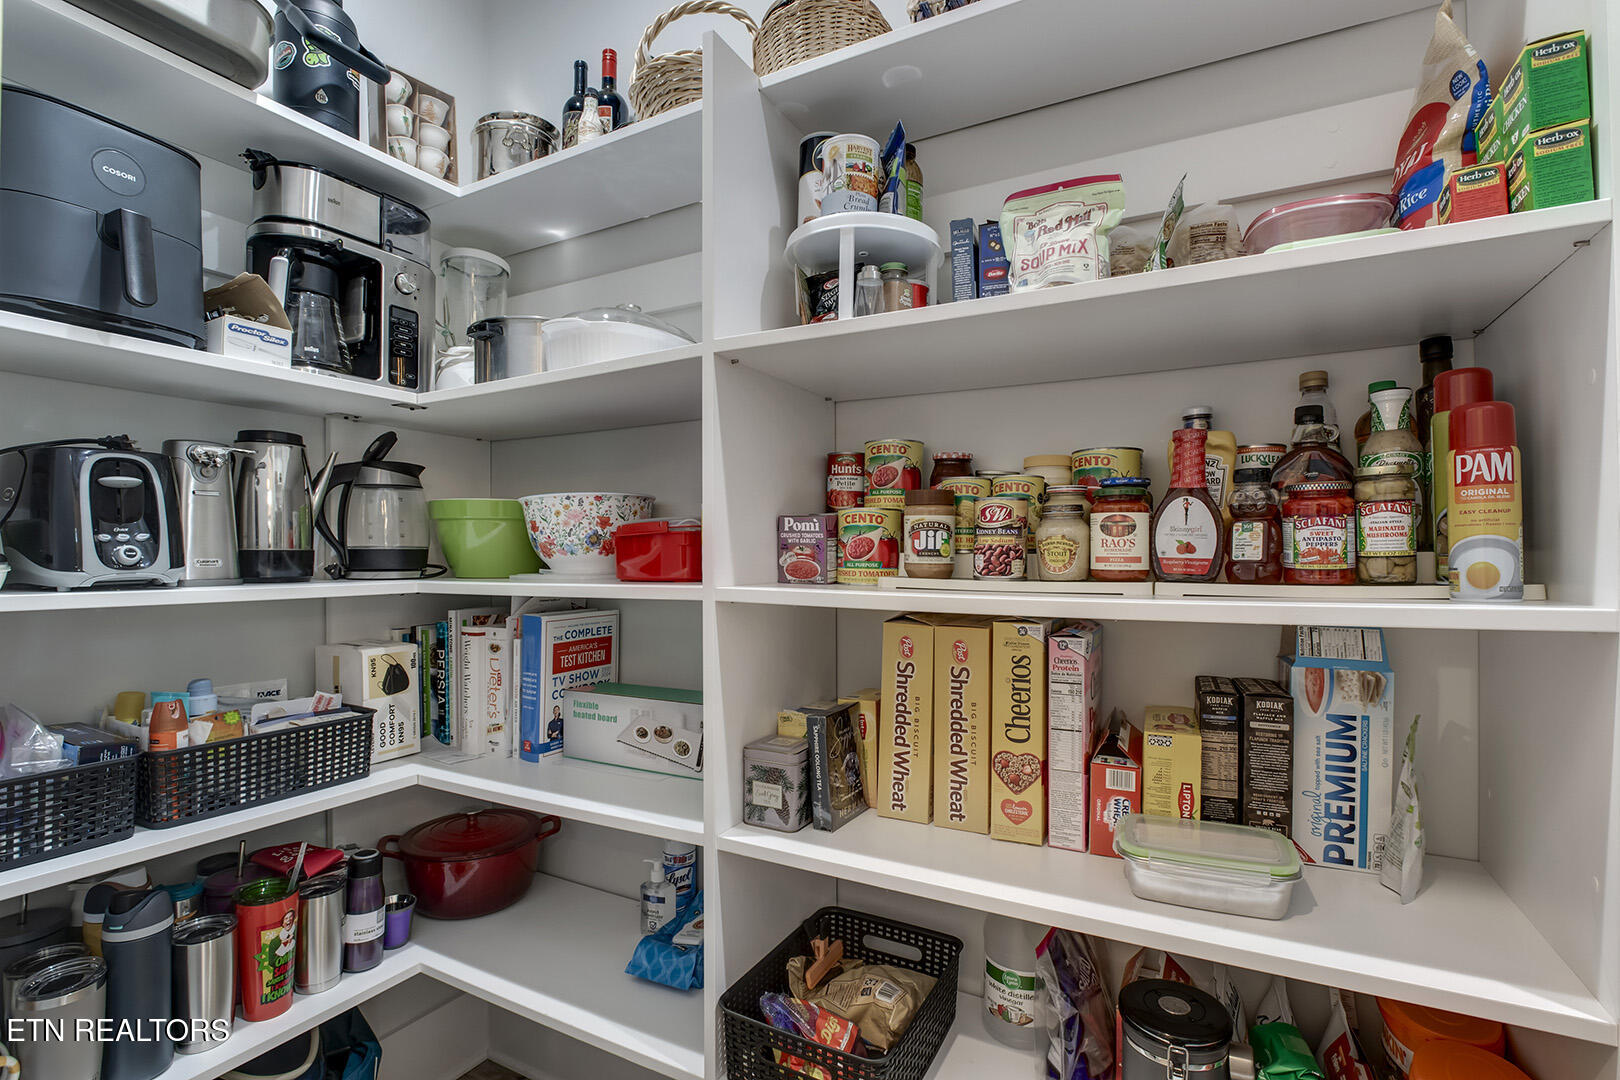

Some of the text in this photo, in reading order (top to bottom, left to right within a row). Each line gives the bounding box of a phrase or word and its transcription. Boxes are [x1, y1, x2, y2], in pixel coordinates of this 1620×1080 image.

[102, 166, 136, 182] COSORI
[848, 194, 870, 206] Bread
[1400, 188, 1428, 213] Rice
[1037, 209, 1092, 237] Red Mill
[1020, 247, 1055, 272] SOUP
[1058, 238, 1088, 256] MIX
[230, 324, 288, 346] Proctor Silex
[870, 444, 907, 455] CENTO
[832, 464, 862, 474] Hunt's
[1073, 456, 1111, 468] CENTO
[1455, 452, 1513, 484] PAM
[993, 482, 1030, 494] CENTO
[1460, 488, 1510, 496] ORIGINAL
[884, 496, 905, 504] TOMAT
[1360, 504, 1411, 516] SCLAFANI
[784, 517, 820, 532] Pomì
[844, 514, 884, 525] CENTO
[914, 522, 948, 530] NATURAL
[1295, 517, 1345, 528] SCLAFANI
[914, 530, 948, 550] Jif
[1101, 538, 1136, 548] RAO'S
[564, 626, 613, 640] COMPLETE
[568, 642, 598, 652] AMERICA'S
[901, 636, 914, 656] Post
[954, 642, 968, 662] Post
[560, 649, 606, 668] TEST KITCHEN
[1052, 664, 1080, 672] Protein
[552, 676, 566, 687] TV
[568, 668, 600, 684] SHOW
[489, 658, 501, 718] Dieter's
[1005, 655, 1032, 744] Cheerios
[1206, 696, 1233, 706] KODIAK
[1256, 700, 1284, 711] KODIAK
[388, 703, 396, 746] COMFORT
[573, 710, 618, 723] heated board
[892, 661, 915, 811] Shredded Wheat
[950, 666, 970, 822] Shredded Wheat
[814, 754, 822, 779] OOLONG
[1323, 712, 1357, 866] PREMIUM
[1122, 799, 1130, 816] CRE
[1182, 784, 1190, 818] LIPTON
[1302, 790, 1332, 836] original
[668, 868, 692, 886] Lysol
[1008, 990, 1034, 1002] distille
